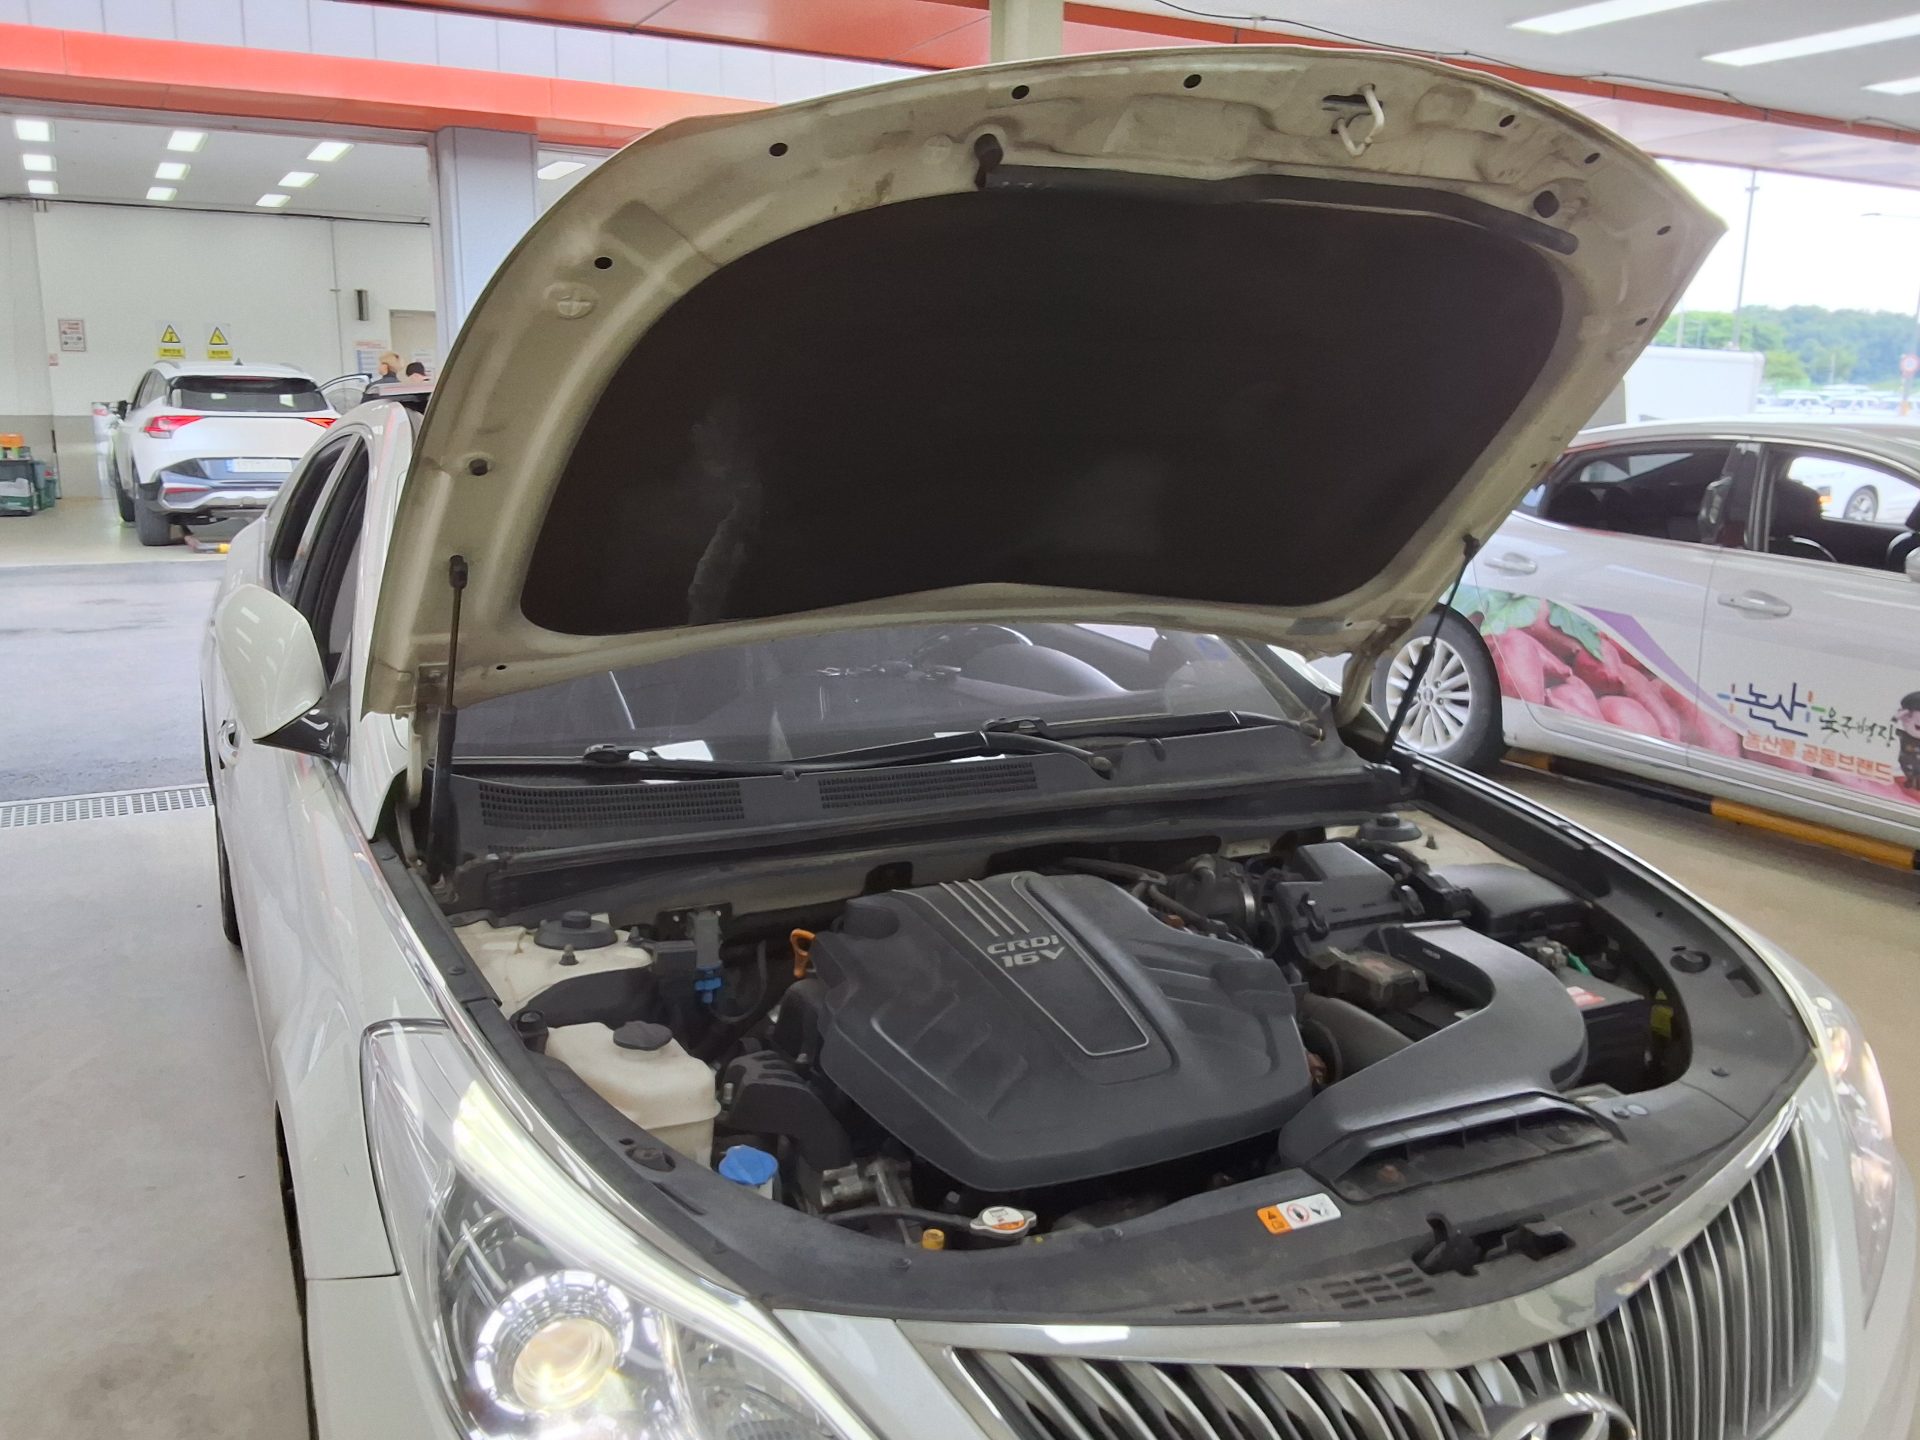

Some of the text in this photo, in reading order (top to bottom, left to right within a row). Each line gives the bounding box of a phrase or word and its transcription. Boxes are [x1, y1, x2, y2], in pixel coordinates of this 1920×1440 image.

[1734, 682, 1808, 737] 논산
[1802, 743, 1893, 782] 공동브랜드
[1001, 946, 1065, 967] 16V
